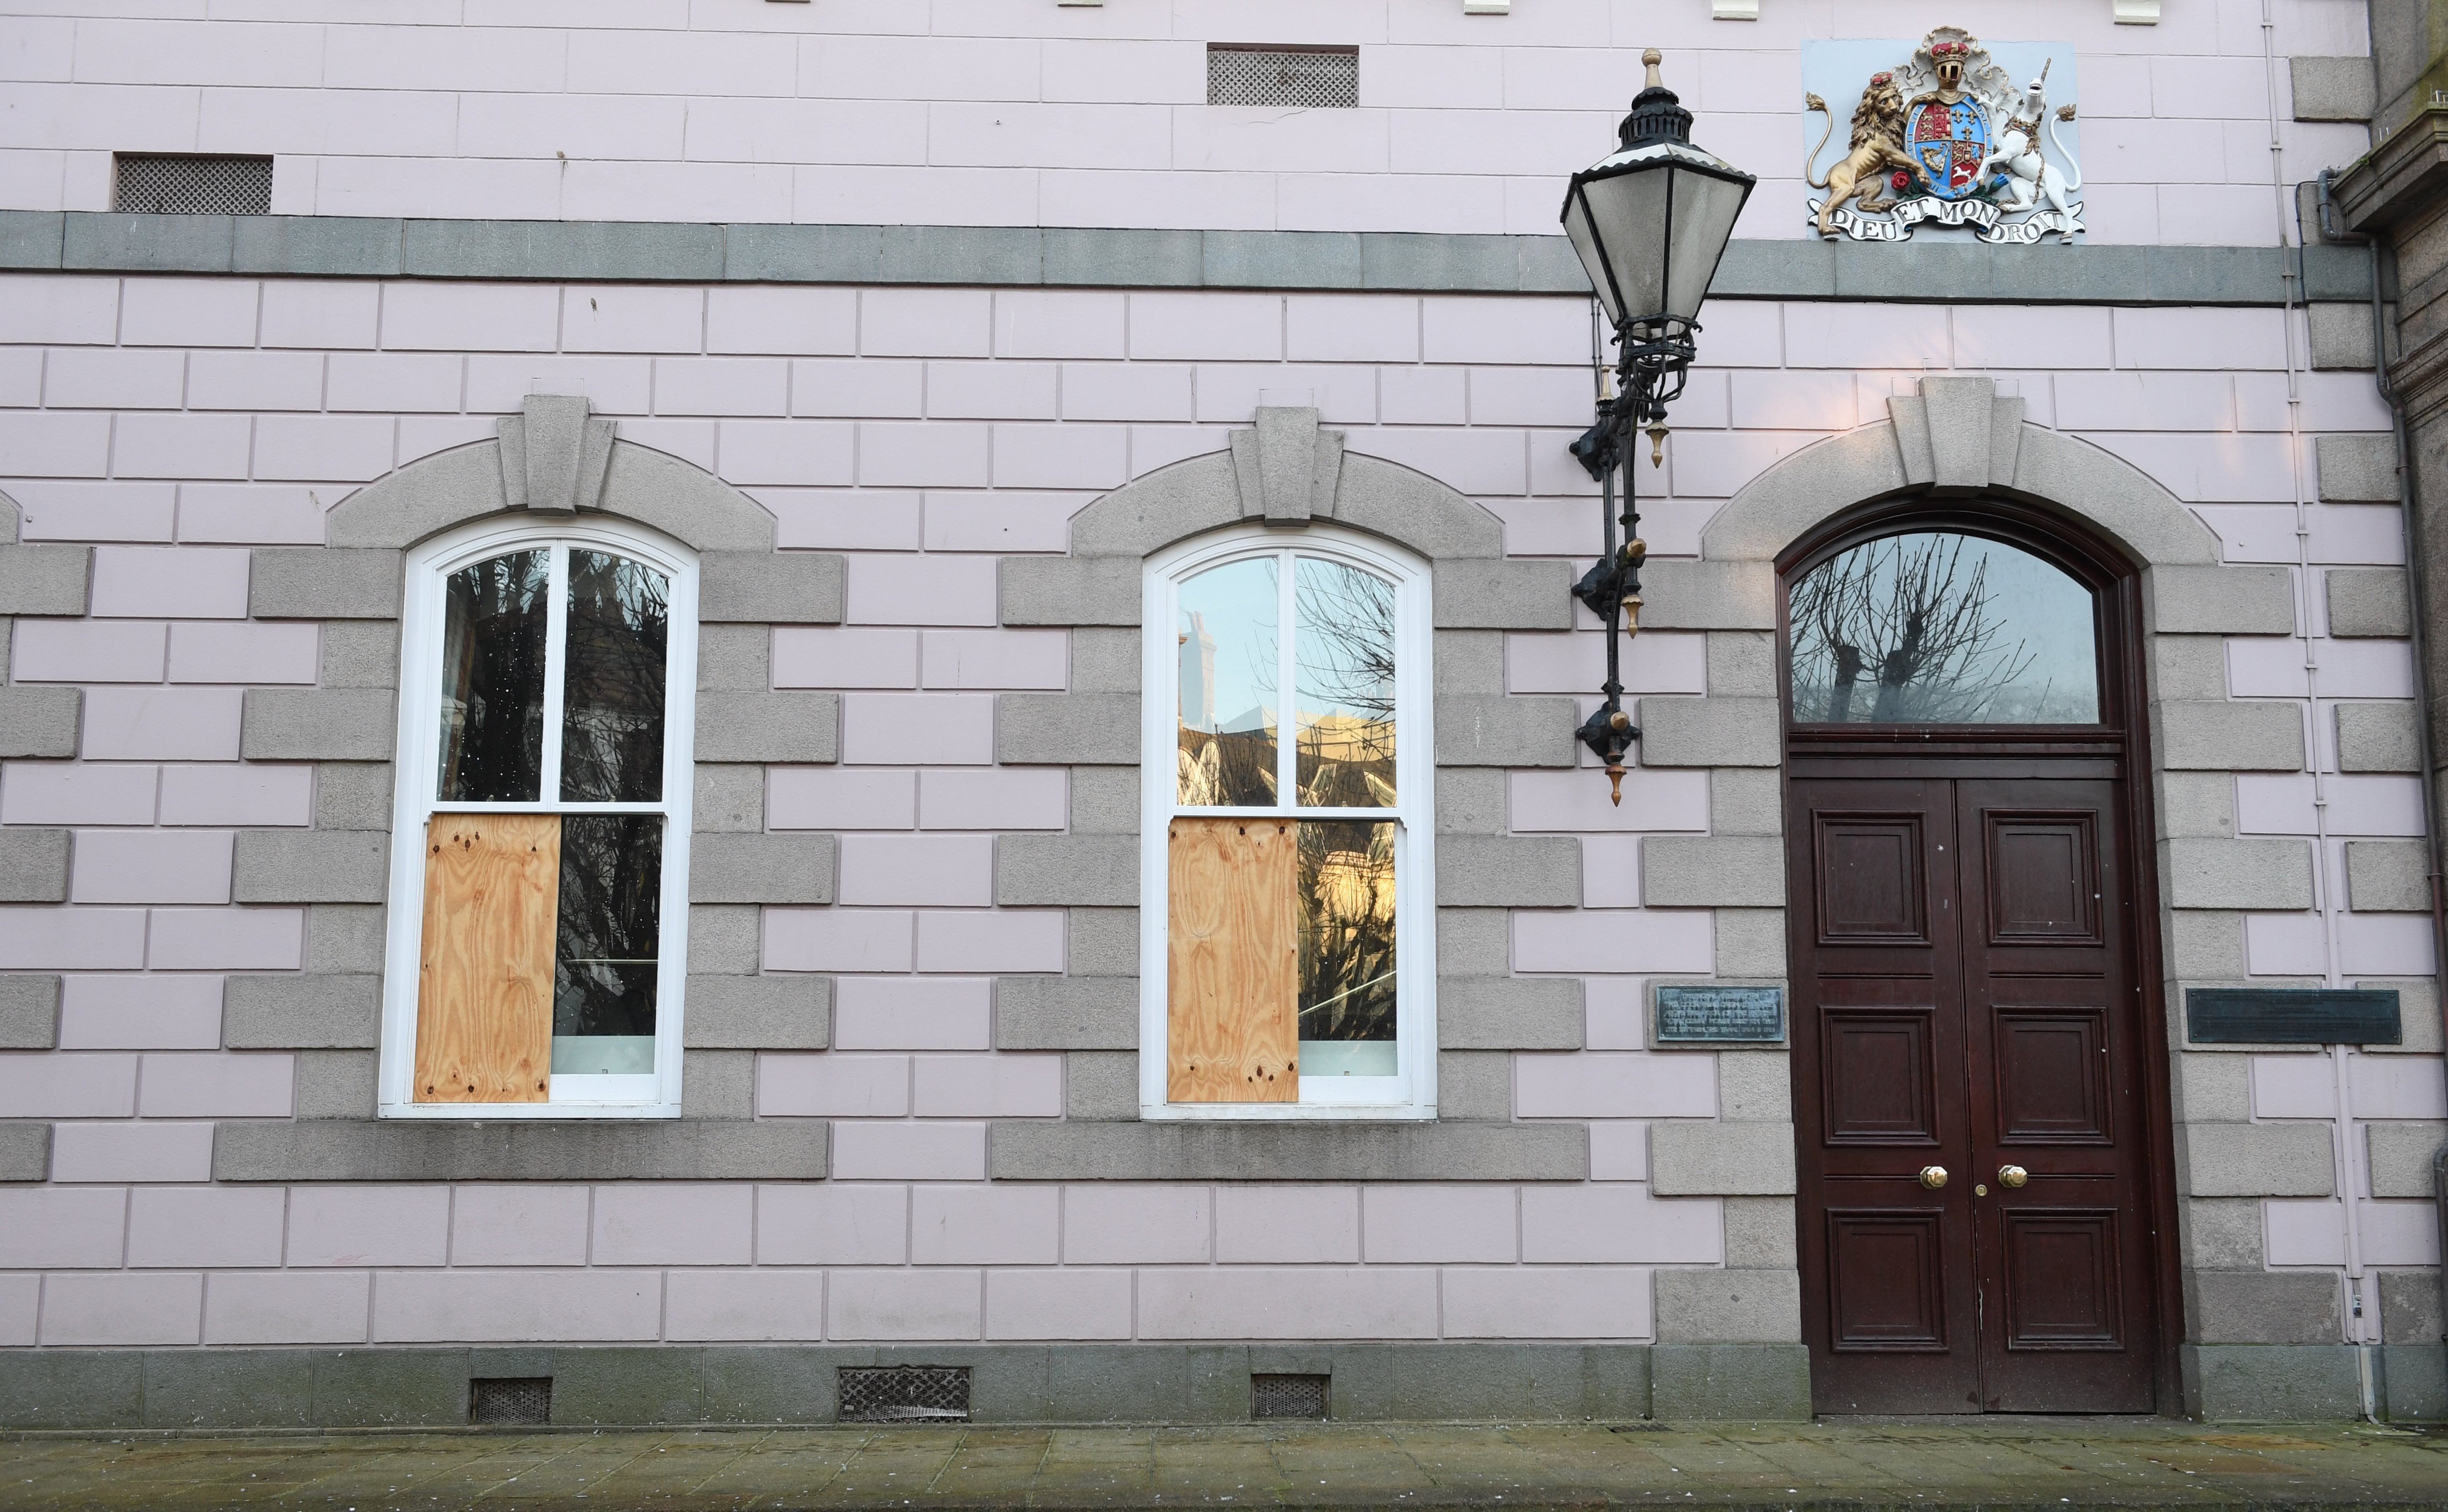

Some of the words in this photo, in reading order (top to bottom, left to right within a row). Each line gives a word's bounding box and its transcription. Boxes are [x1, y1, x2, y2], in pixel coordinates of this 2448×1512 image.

[1830, 209, 1896, 240] DIEU
[1893, 198, 1929, 224] ET
[1939, 201, 1998, 224] MON
[1985, 212, 2063, 240] DROIT
